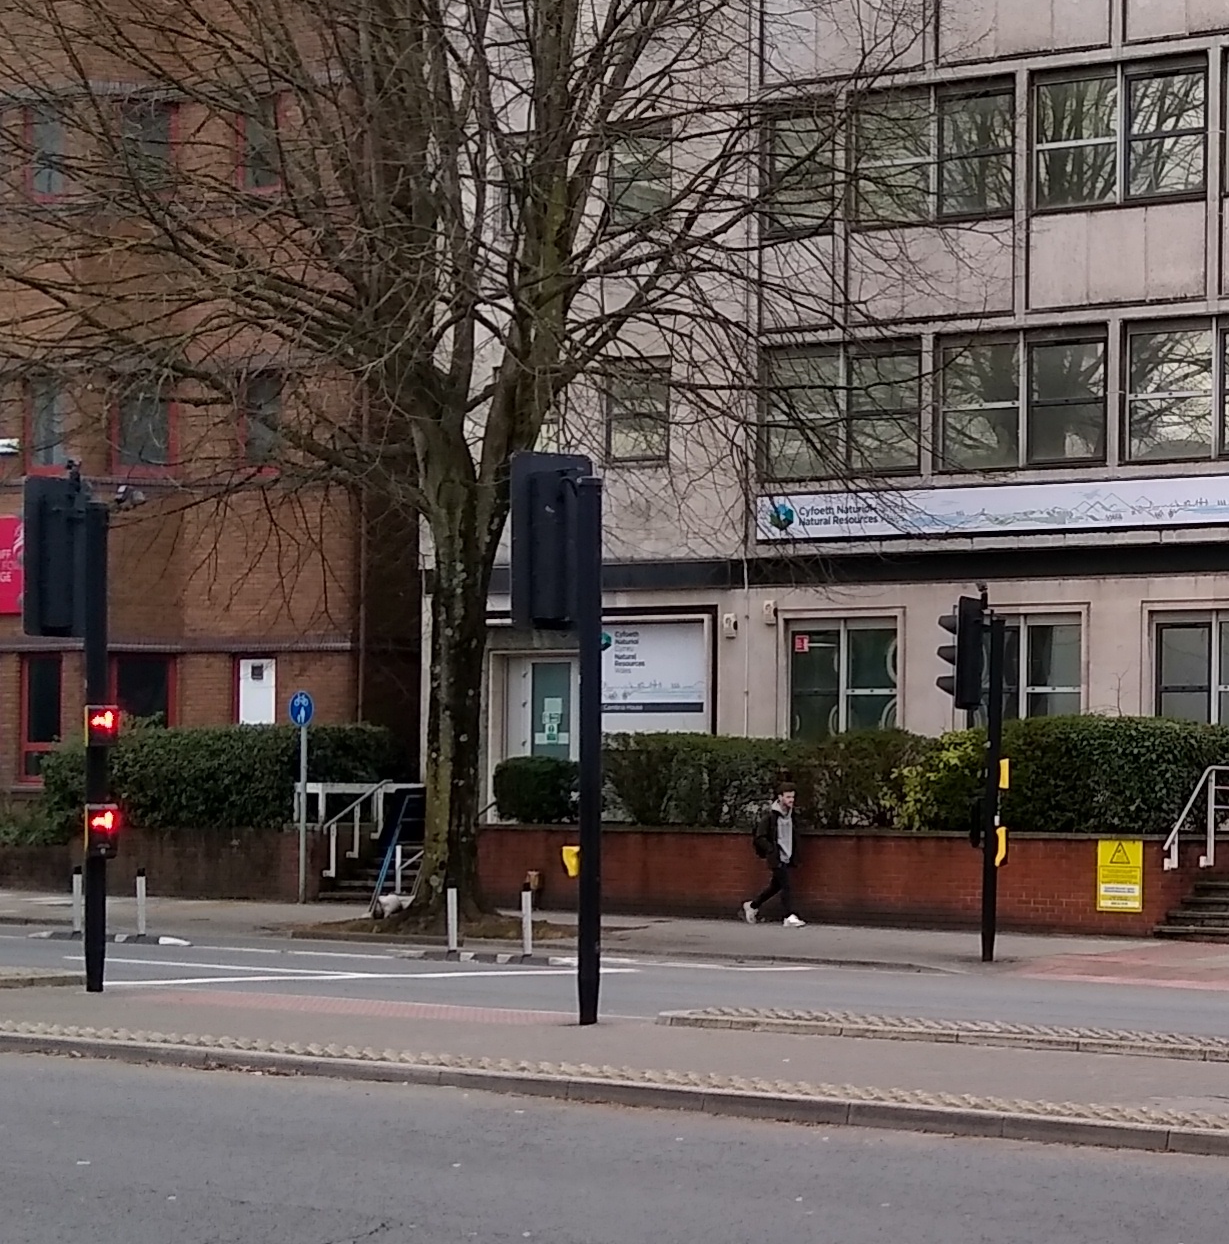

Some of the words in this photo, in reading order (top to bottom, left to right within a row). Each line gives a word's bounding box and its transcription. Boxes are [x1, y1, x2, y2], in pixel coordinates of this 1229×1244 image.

[798, 506, 834, 517] Cyfoeth
[798, 515, 831, 526] Natural
[832, 514, 878, 525] Resources
